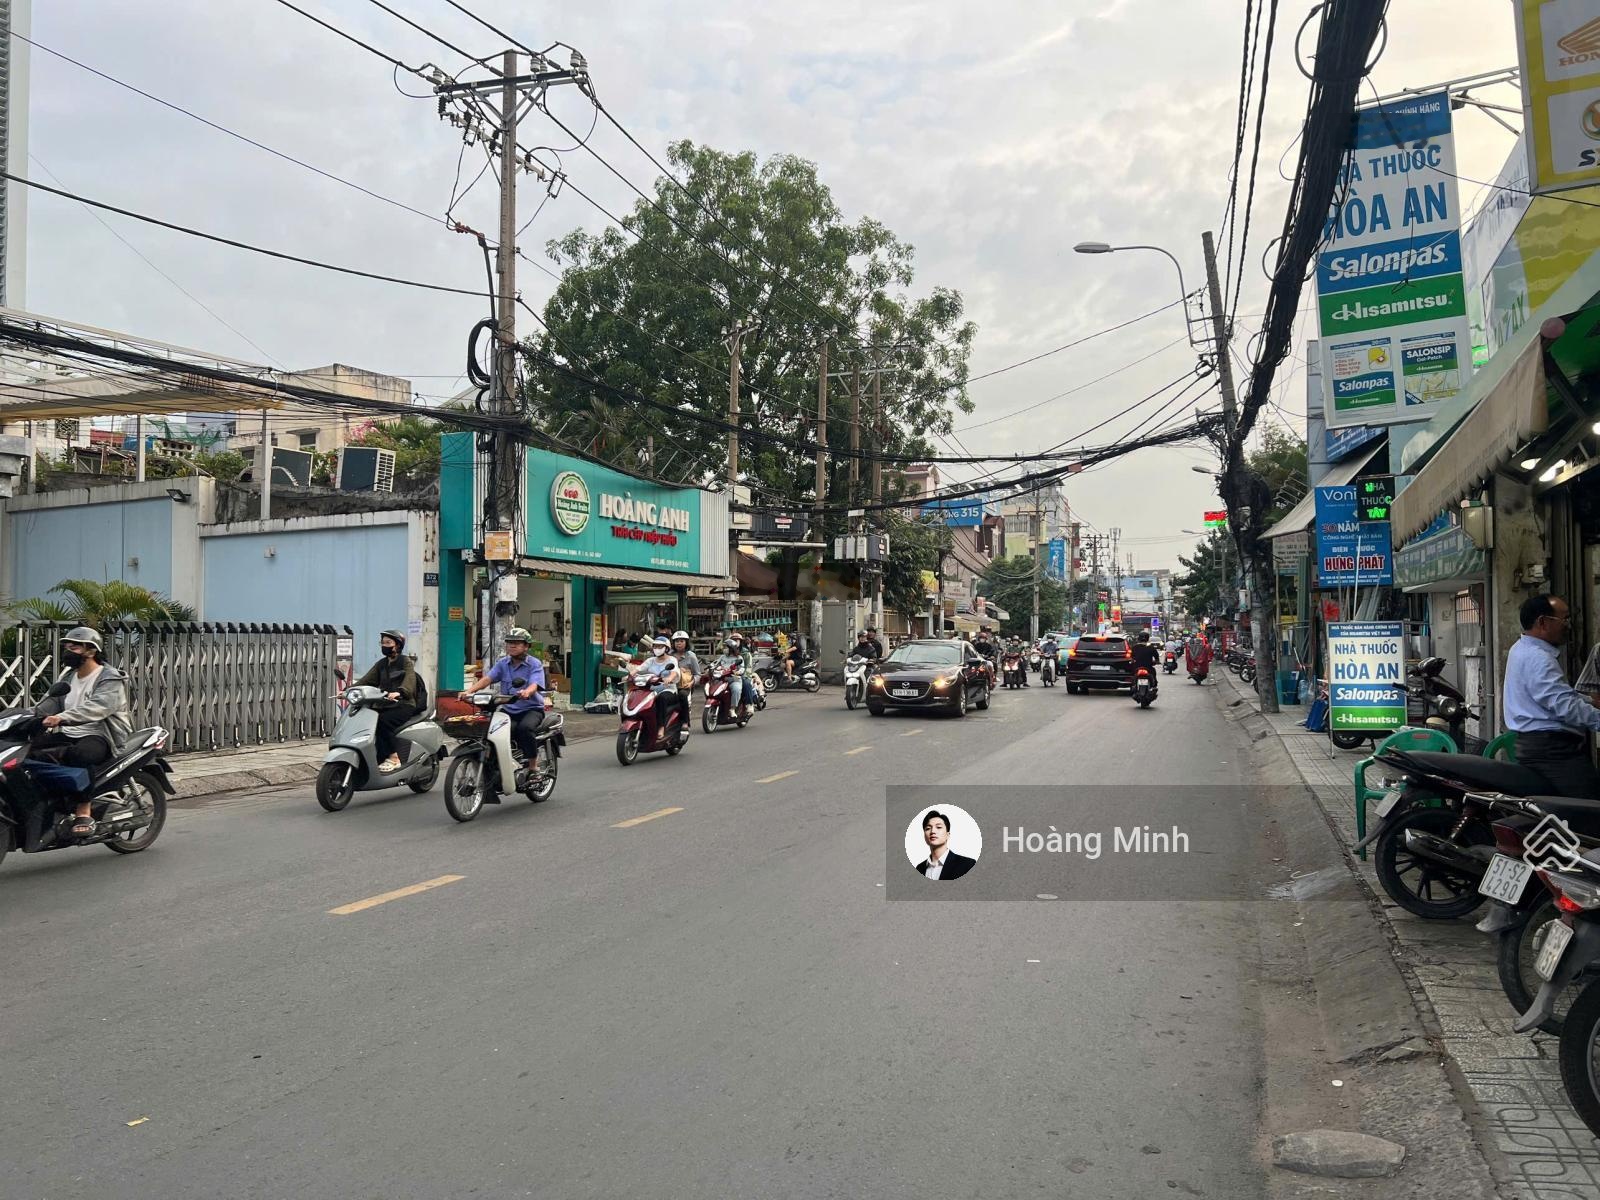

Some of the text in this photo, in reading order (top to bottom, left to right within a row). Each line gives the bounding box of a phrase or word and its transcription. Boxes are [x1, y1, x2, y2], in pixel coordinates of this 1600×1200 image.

[1402, 182, 1448, 227] AN
[1329, 243, 1448, 281] Salonpas
[1331, 294, 1448, 321] Hisamitsu
[1406, 345, 1451, 359] SALONSIP
[1338, 377, 1389, 392] Salonpas
[599, 491, 690, 532] HOÀNG ANH
[962, 507, 980, 518] 315
[1338, 519, 1360, 532] NĂM
[1335, 639, 1398, 655] NHÀ THUỐC
[1335, 659, 1399, 679] HÒA AN
[1336, 687, 1398, 703] Salonpas
[1336, 713, 1398, 724] Hisamitsu
